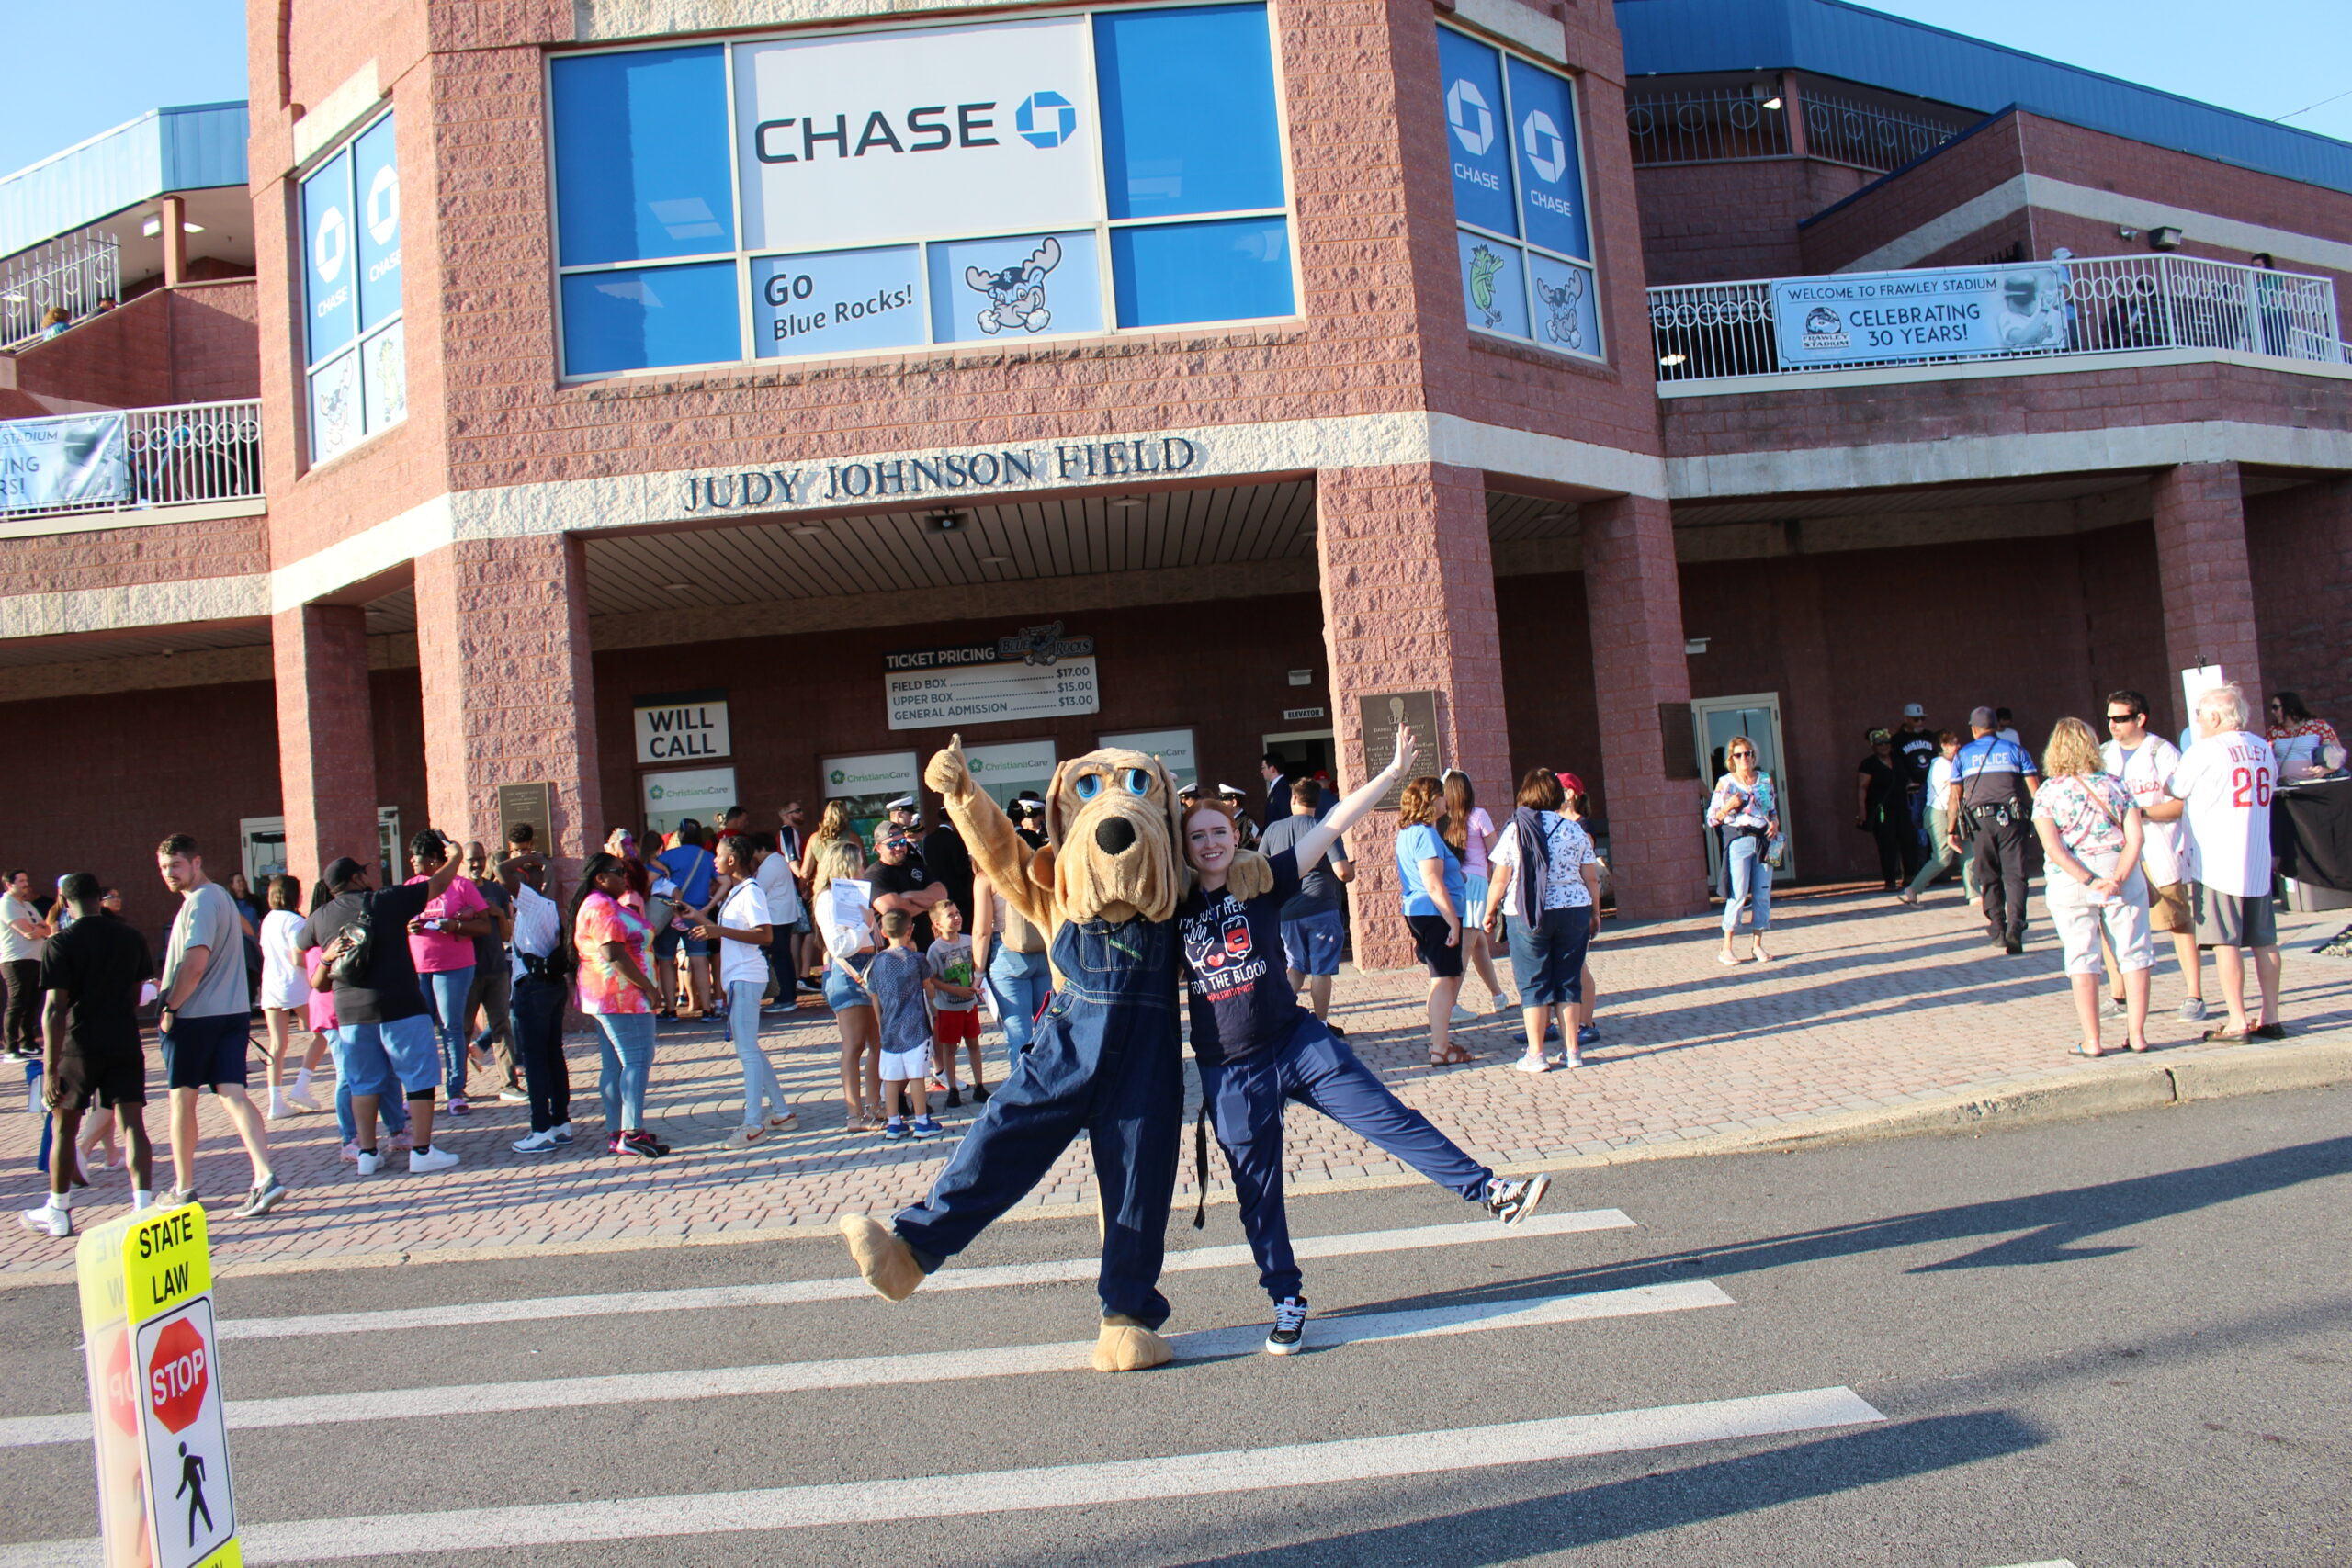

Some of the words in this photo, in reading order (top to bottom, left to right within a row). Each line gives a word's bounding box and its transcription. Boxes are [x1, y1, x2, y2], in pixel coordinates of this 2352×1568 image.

[755, 102, 1000, 164] CHASE
[1454, 163, 1499, 191] CHASE
[1531, 190, 1572, 217] CHASE
[369, 248, 402, 282] CHASE
[764, 274, 813, 307] Go
[1788, 286, 1853, 299] WELCOME
[1859, 285, 1876, 297] TO
[1880, 281, 1938, 295] FRAWLEY
[1943, 278, 1996, 291] STADIUM
[317, 285, 348, 318] CHASE
[773, 313, 826, 341] Blue
[834, 284, 912, 324] Rocks!
[1849, 303, 1981, 327] CELEBRATING
[1868, 331, 1894, 347] 30
[1900, 324, 1968, 344] YEARS!
[3, 431, 58, 445] STADIUM
[684, 468, 802, 512] JUDY
[824, 447, 1036, 500] JOHNSON
[1055, 437, 1194, 479] FIELD
[886, 652, 934, 668] TICKET
[938, 647, 995, 663] PRICING
[1056, 639, 1091, 654] ROCKS
[892, 680, 922, 692] FIELD
[924, 678, 947, 689] BOX
[1057, 667, 1090, 679] $17.00
[893, 694, 928, 706] UPPER
[931, 693, 953, 703] BOX
[1057, 681, 1092, 694] $15.00
[648, 707, 714, 732] WILL
[894, 707, 944, 721] GENERAL
[947, 703, 1008, 716] ADMISSION
[1058, 695, 1093, 707] $13.00
[1288, 709, 1319, 718] ELEVATOR
[650, 733, 716, 758] CALL
[2228, 745, 2267, 762] UTLEY
[985, 759, 1047, 771] ChristianaCare
[1972, 752, 2008, 766] POLICE
[847, 772, 910, 783] ChristianaCare
[2233, 767, 2270, 808] 26
[666, 786, 728, 797] ChristianaCare
[1179, 919, 1194, 931] I'M
[1224, 900, 1248, 916] HER
[1208, 973, 1231, 991] THE
[1233, 960, 1267, 985] BLOOD
[139, 1212, 193, 1259] STATE
[153, 1261, 188, 1305] LAW
[153, 1348, 205, 1406] STOP
